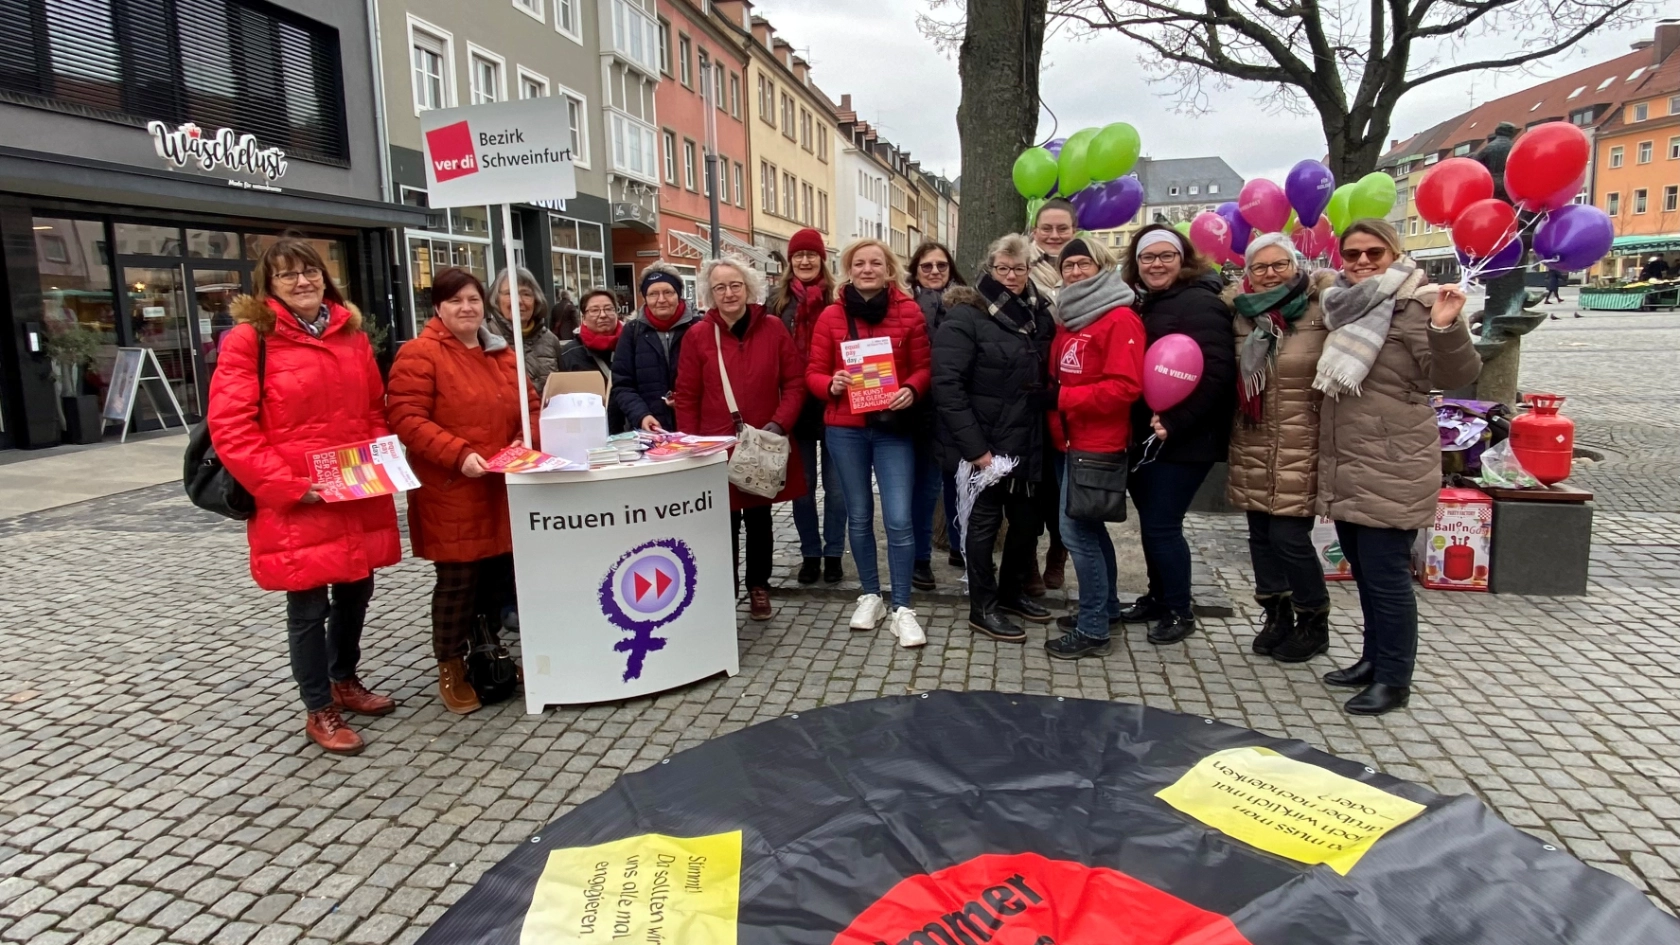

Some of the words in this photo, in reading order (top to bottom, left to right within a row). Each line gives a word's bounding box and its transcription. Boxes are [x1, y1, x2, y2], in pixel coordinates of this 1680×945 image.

[479, 128, 525, 147] Bezirk
[434, 154, 474, 171] ver.di
[482, 148, 572, 169] Schweinfurt
[845, 343, 860, 351] equal
[1154, 364, 1169, 375] FÜR
[1169, 369, 1198, 382] VIELFALT
[852, 396, 865, 404] DER
[862, 387, 884, 396] KUNST
[327, 451, 338, 465] DIE
[371, 444, 380, 457] day
[380, 442, 389, 455] pay
[388, 441, 399, 459] equal
[320, 452, 330, 469] DER
[331, 466, 347, 490] KUNST
[529, 511, 615, 531] Frauen
[624, 504, 647, 525] in
[654, 490, 713, 520] ver.di
[1211, 780, 1245, 797] mal
[1213, 760, 1316, 809] nachdenken
[1232, 804, 1274, 826] man
[1248, 794, 1318, 827] wirklich
[1317, 806, 1384, 833] drüber
[1276, 823, 1325, 846] muss
[623, 854, 640, 878] uns
[685, 855, 707, 893] Stimmt!
[577, 861, 609, 939] engagieren.
[618, 881, 639, 907] alle
[649, 870, 670, 923] sollten
[873, 873, 1044, 945] mmer
[612, 910, 631, 940] mal
[646, 926, 666, 945] wir
